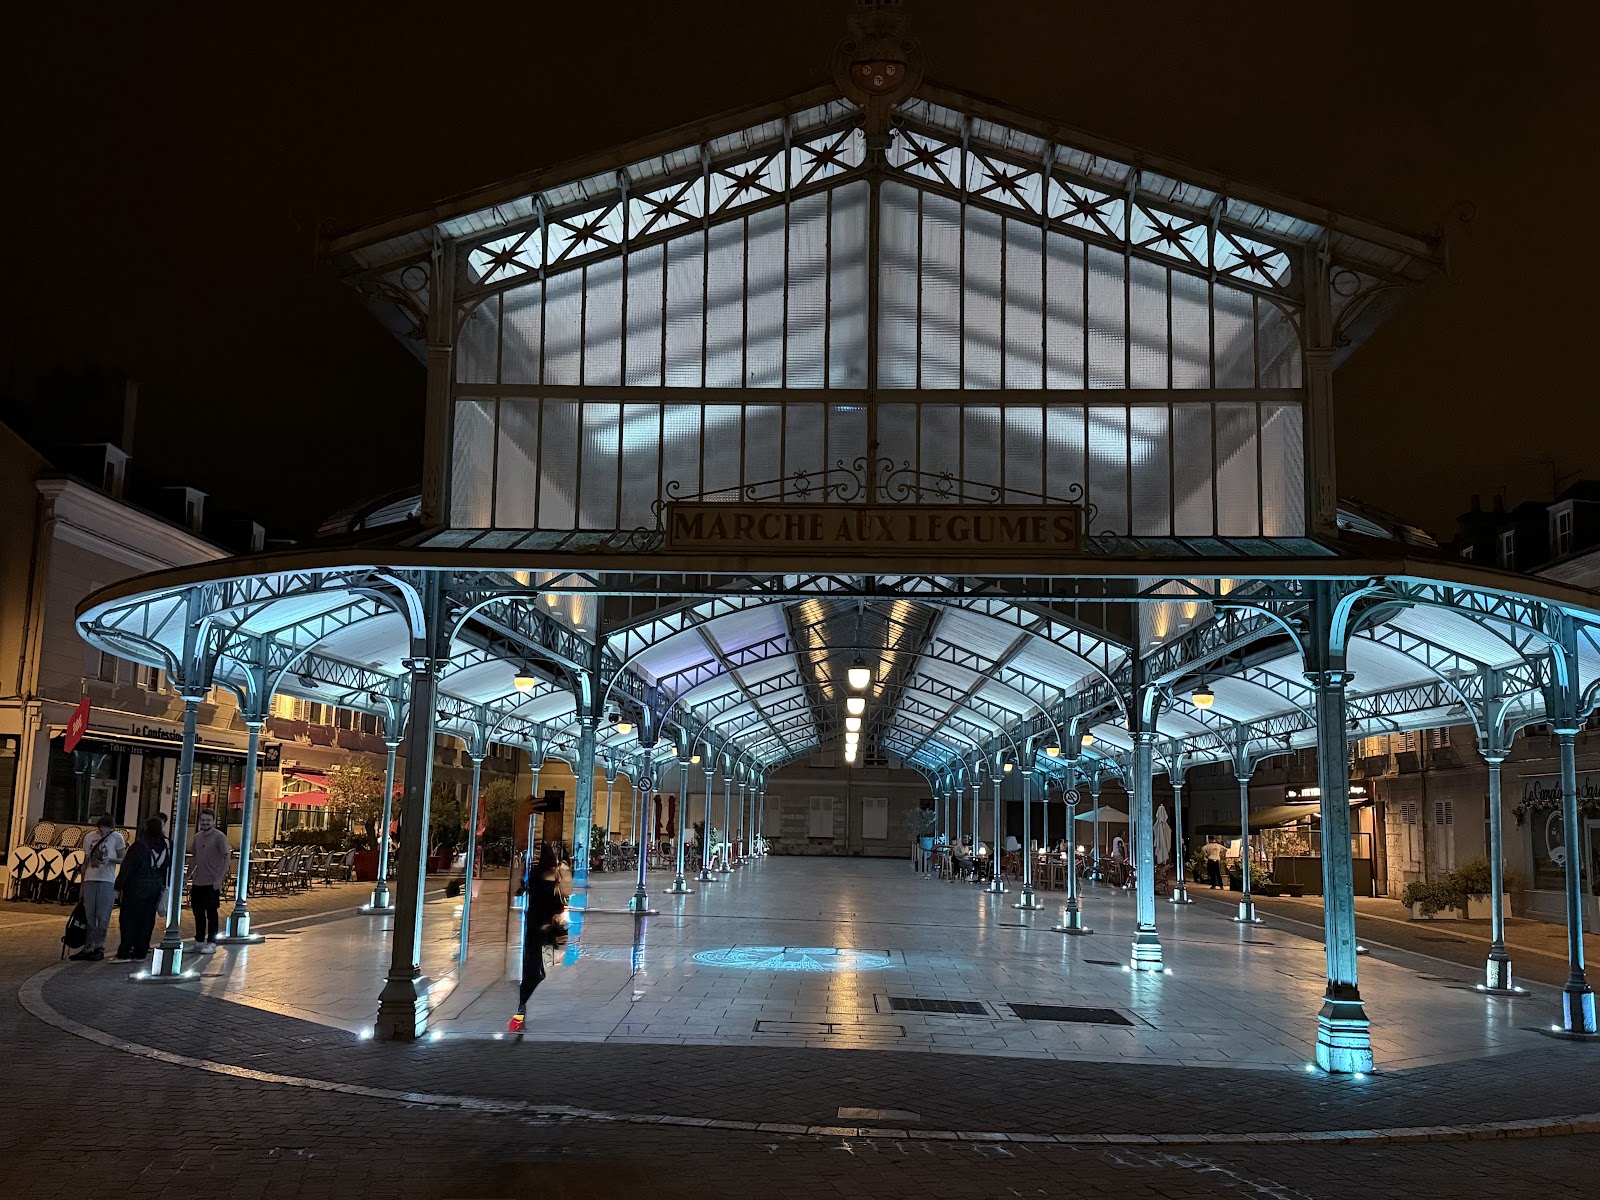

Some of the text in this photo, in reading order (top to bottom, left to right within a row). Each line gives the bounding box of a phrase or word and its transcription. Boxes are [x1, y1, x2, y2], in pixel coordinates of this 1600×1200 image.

[835, 512, 897, 541] AUX
[131, 724, 141, 736] Le
[109, 742, 126, 753] Tabac
